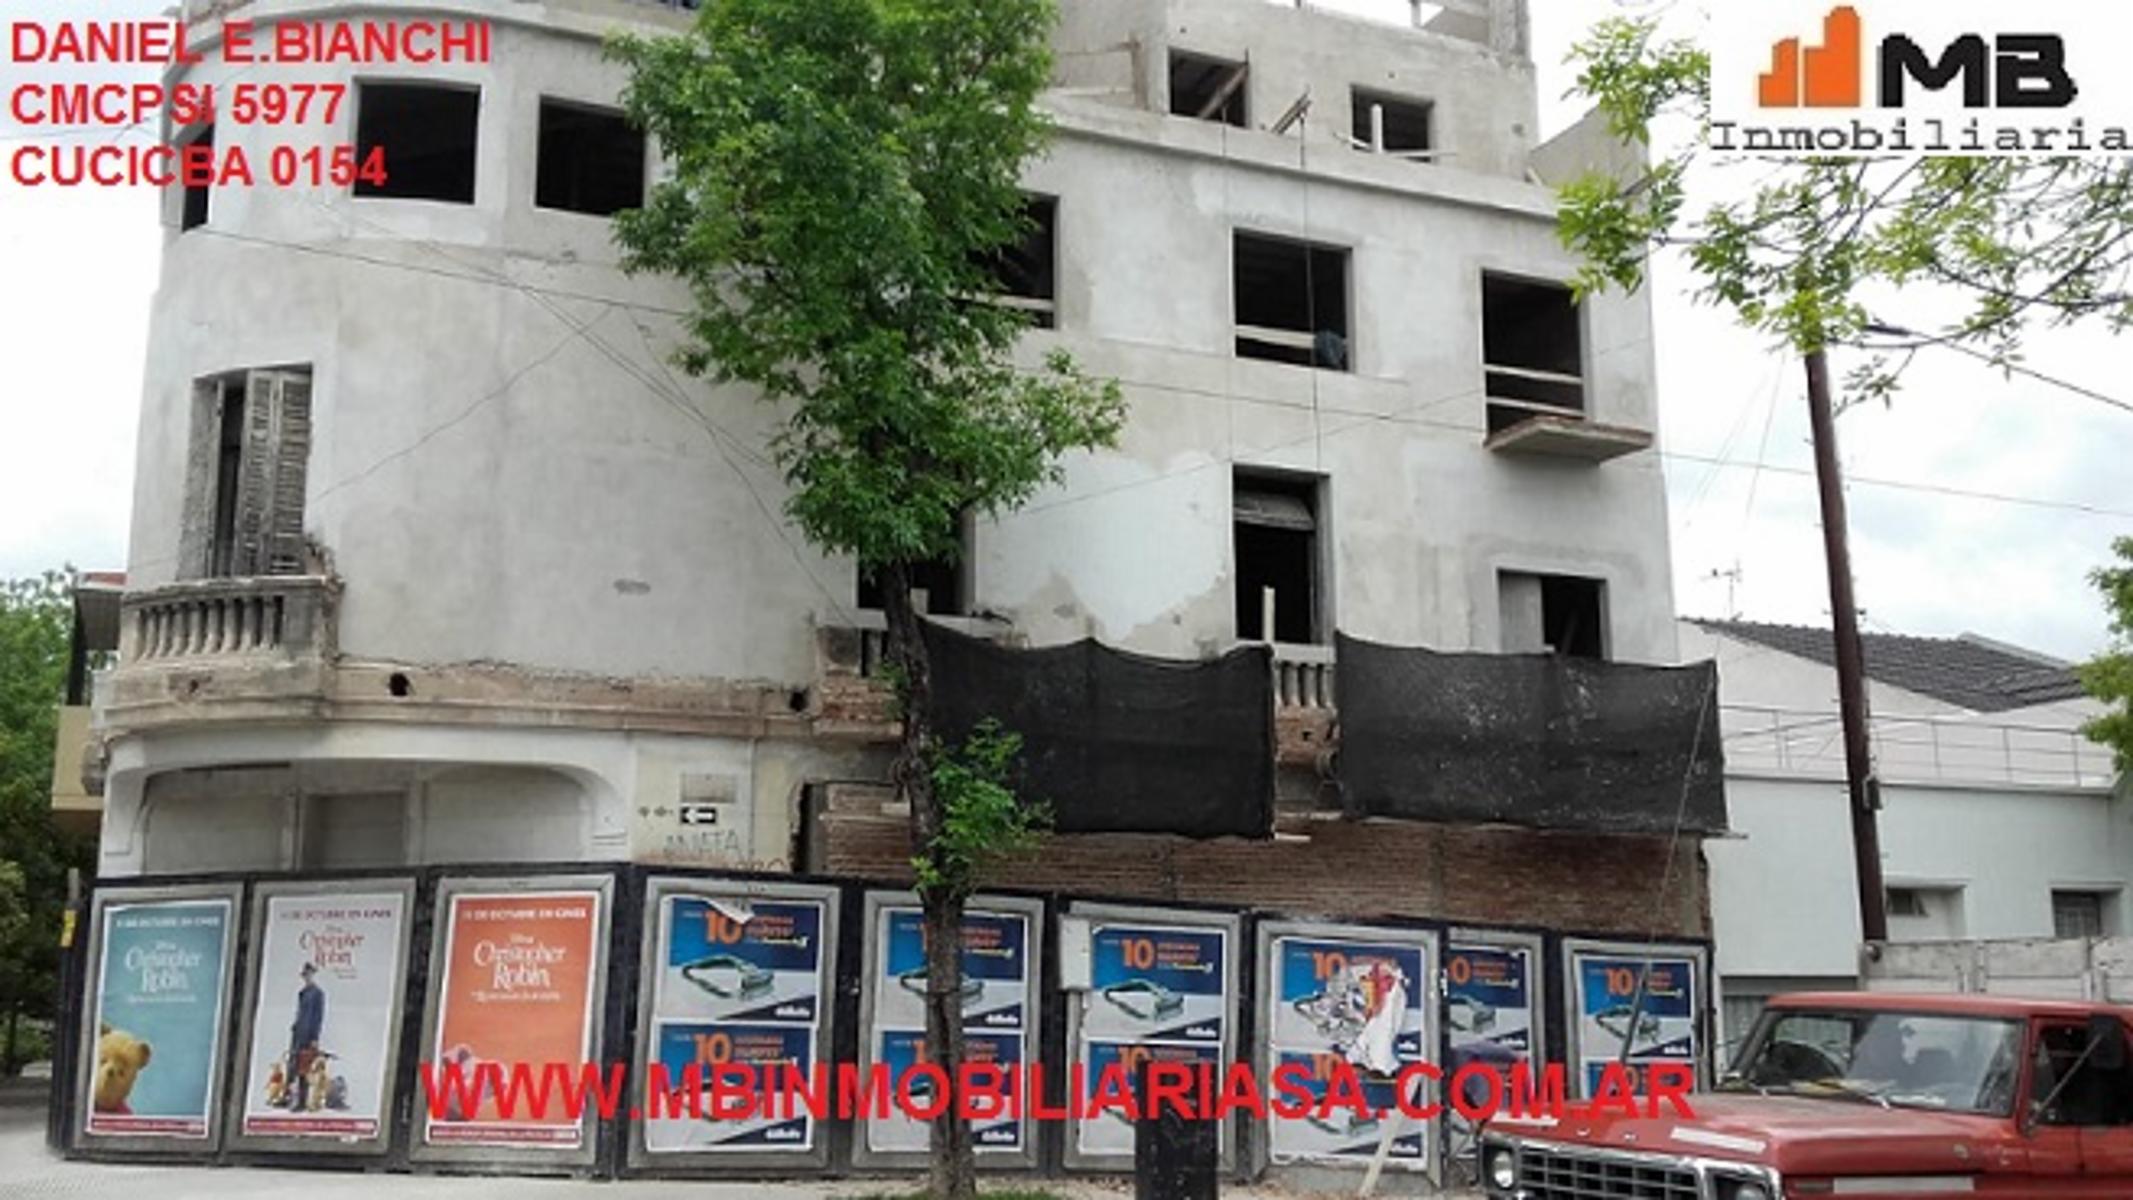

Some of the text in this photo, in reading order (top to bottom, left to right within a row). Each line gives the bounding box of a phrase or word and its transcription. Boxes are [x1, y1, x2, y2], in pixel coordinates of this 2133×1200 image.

[1120, 938, 1154, 970] 10
[1448, 956, 1472, 986] 0
[1605, 967, 1634, 996] 10
